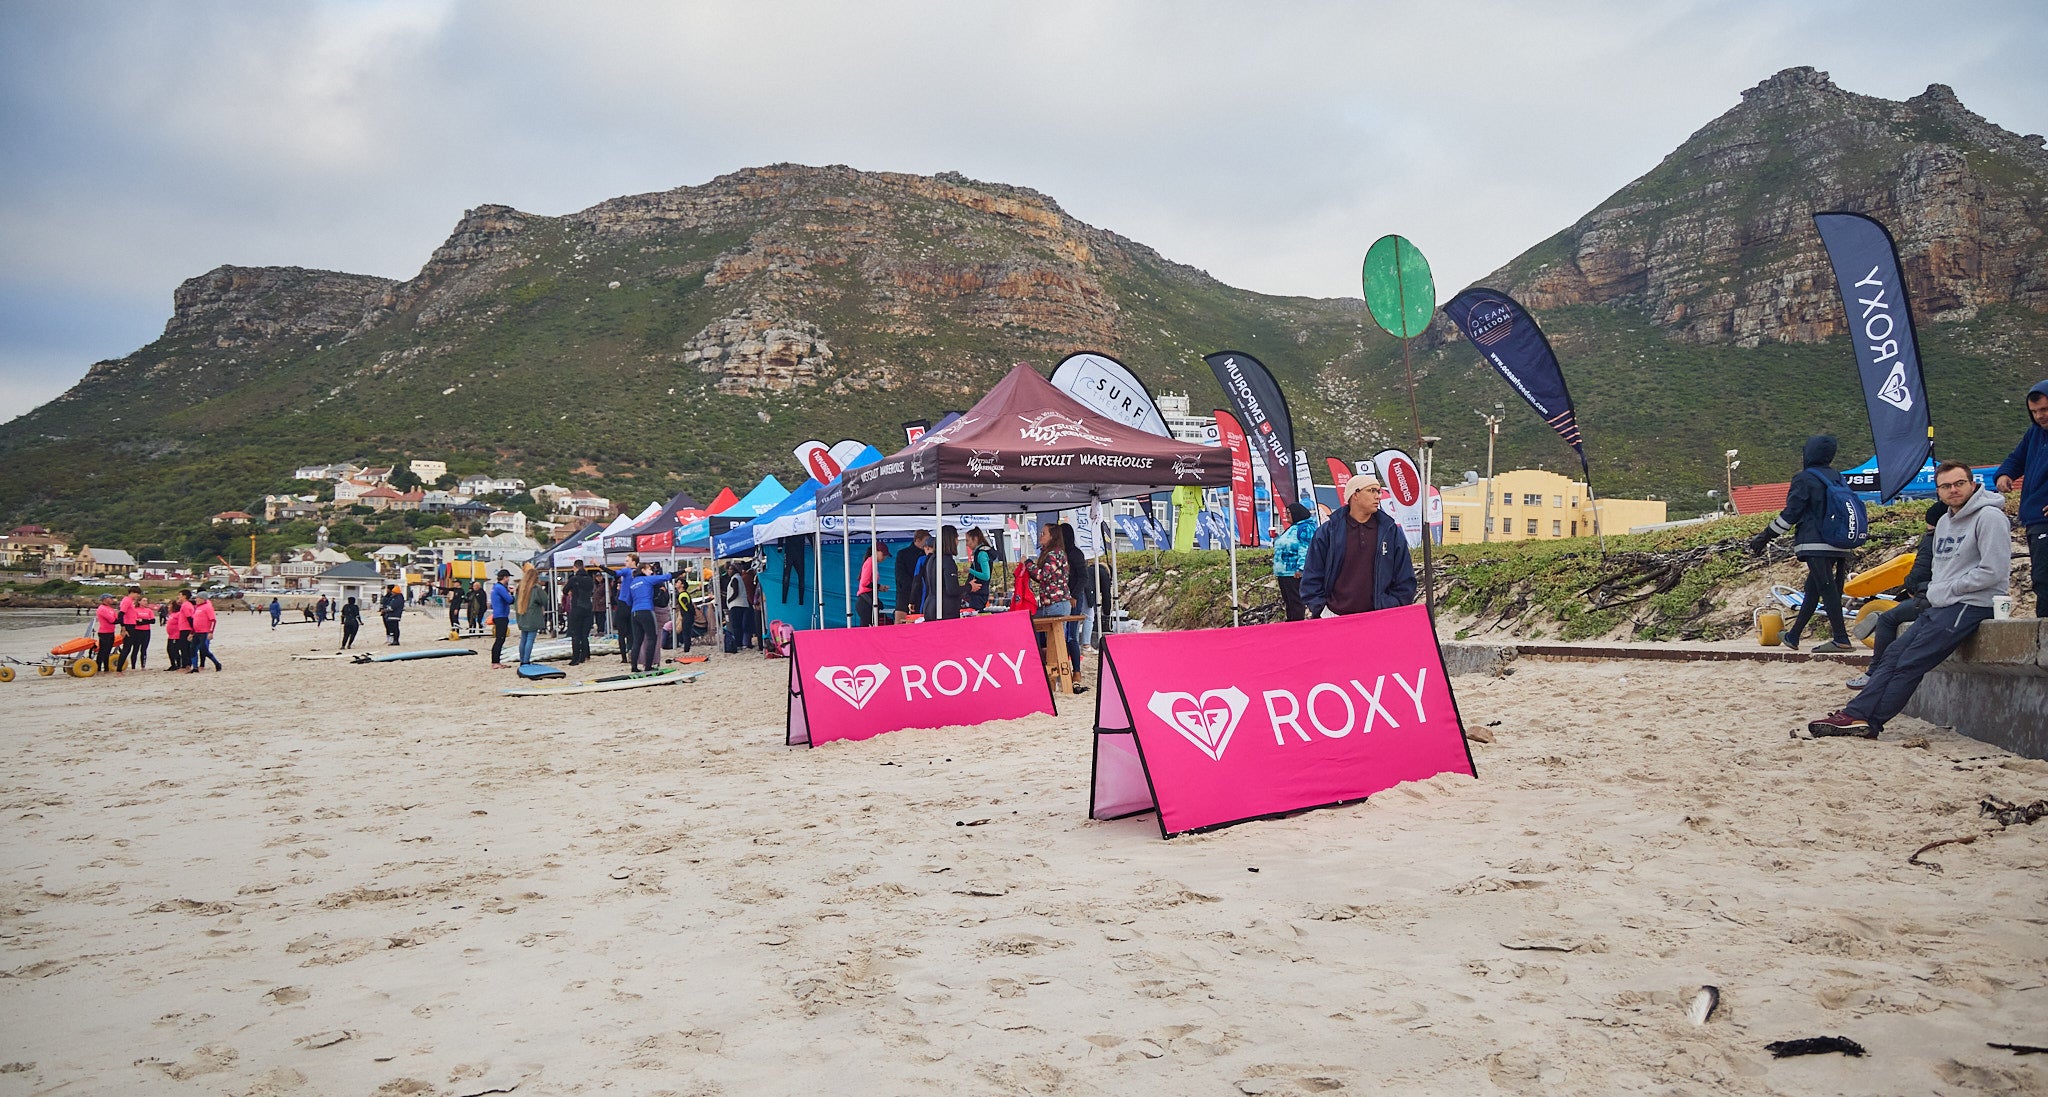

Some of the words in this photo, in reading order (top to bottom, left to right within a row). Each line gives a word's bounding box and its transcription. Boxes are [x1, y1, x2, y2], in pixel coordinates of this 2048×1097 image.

[1471, 306, 1505, 328] OCEAN
[1473, 313, 1510, 337] FREEDOM
[1096, 378, 1144, 418] SURF
[1490, 352, 1549, 415] www.oceanfreedom.com
[812, 451, 835, 482] havaiana
[1020, 454, 1075, 467] WETSUIT
[1079, 454, 1154, 469] WAREHOUSE
[1393, 461, 1413, 502] havaianas
[1846, 475, 1874, 485] USE
[901, 649, 1026, 701] ROXY
[1263, 667, 1427, 746] ROXY
